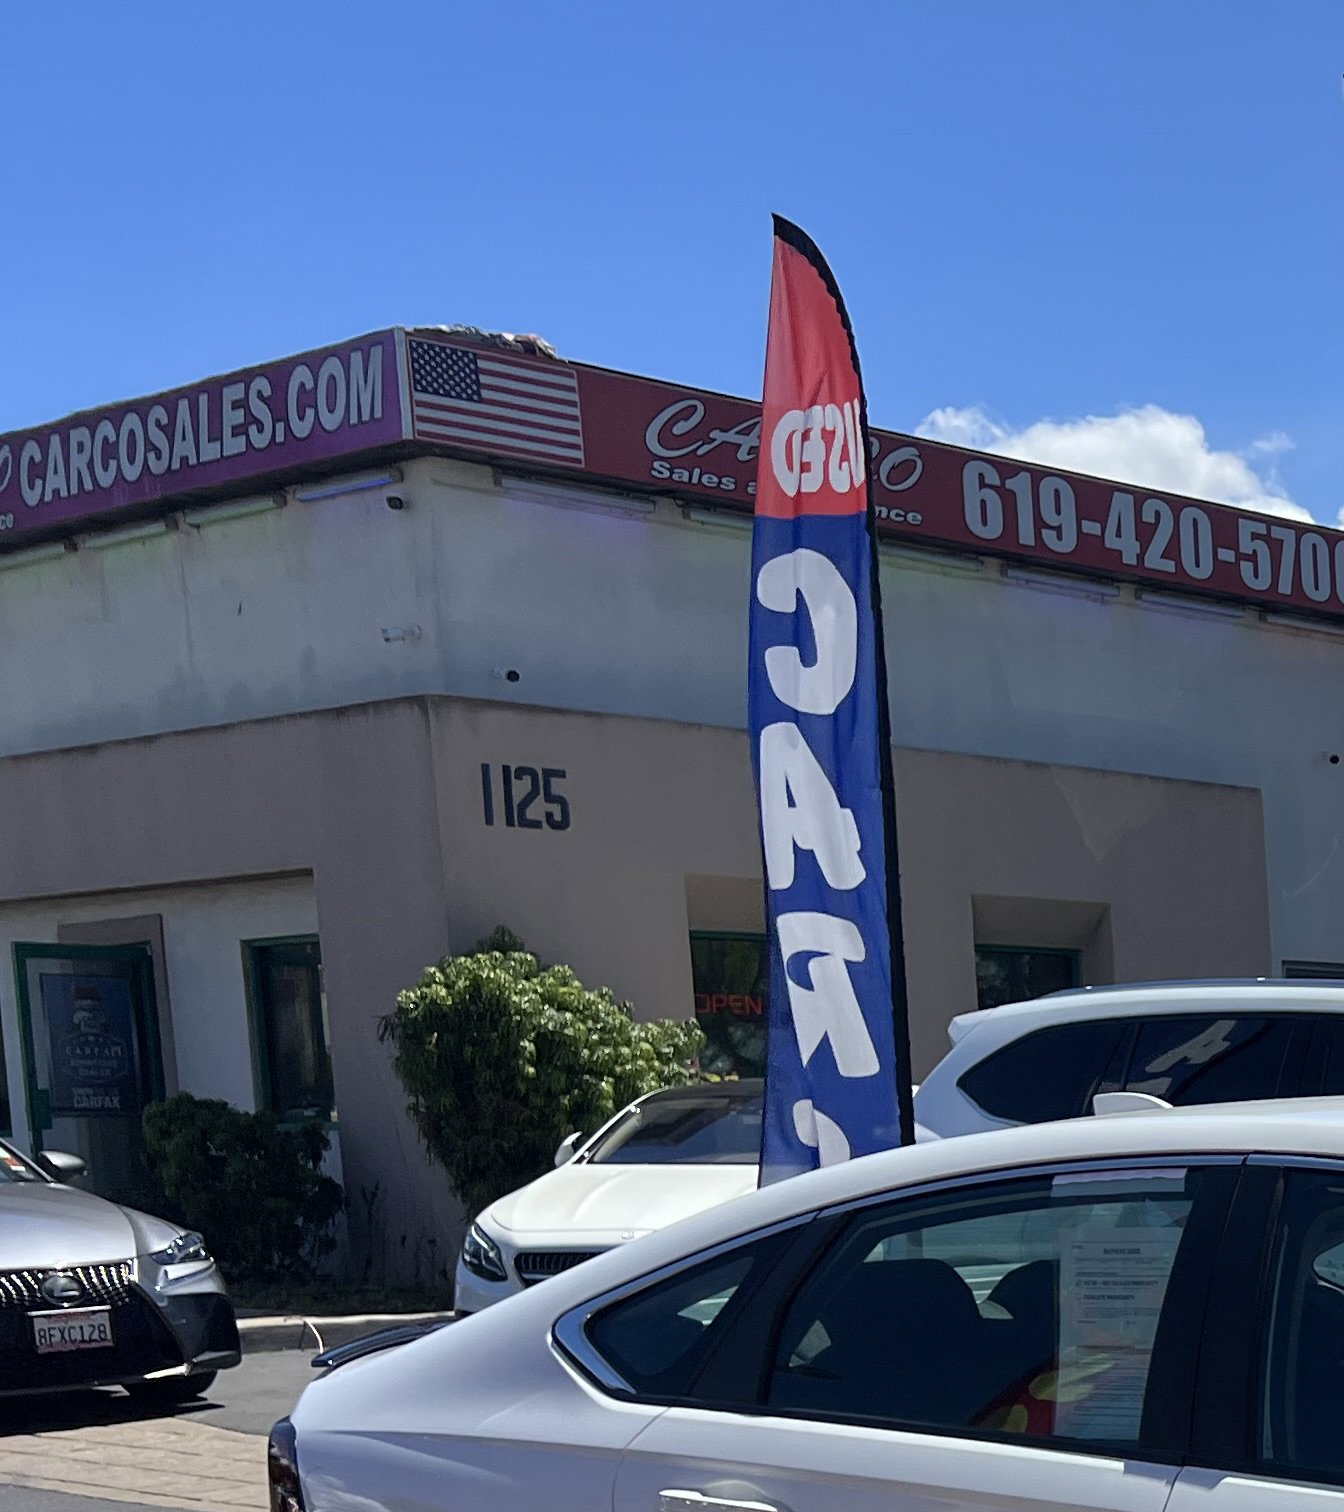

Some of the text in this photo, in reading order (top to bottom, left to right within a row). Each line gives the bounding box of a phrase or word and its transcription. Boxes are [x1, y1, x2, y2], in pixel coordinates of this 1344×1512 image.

[19, 344, 384, 508] CARCOSALES.COM
[644, 399, 924, 492] CAO
[650, 459, 737, 492] Sales
[480, 762, 571, 832] 1125
